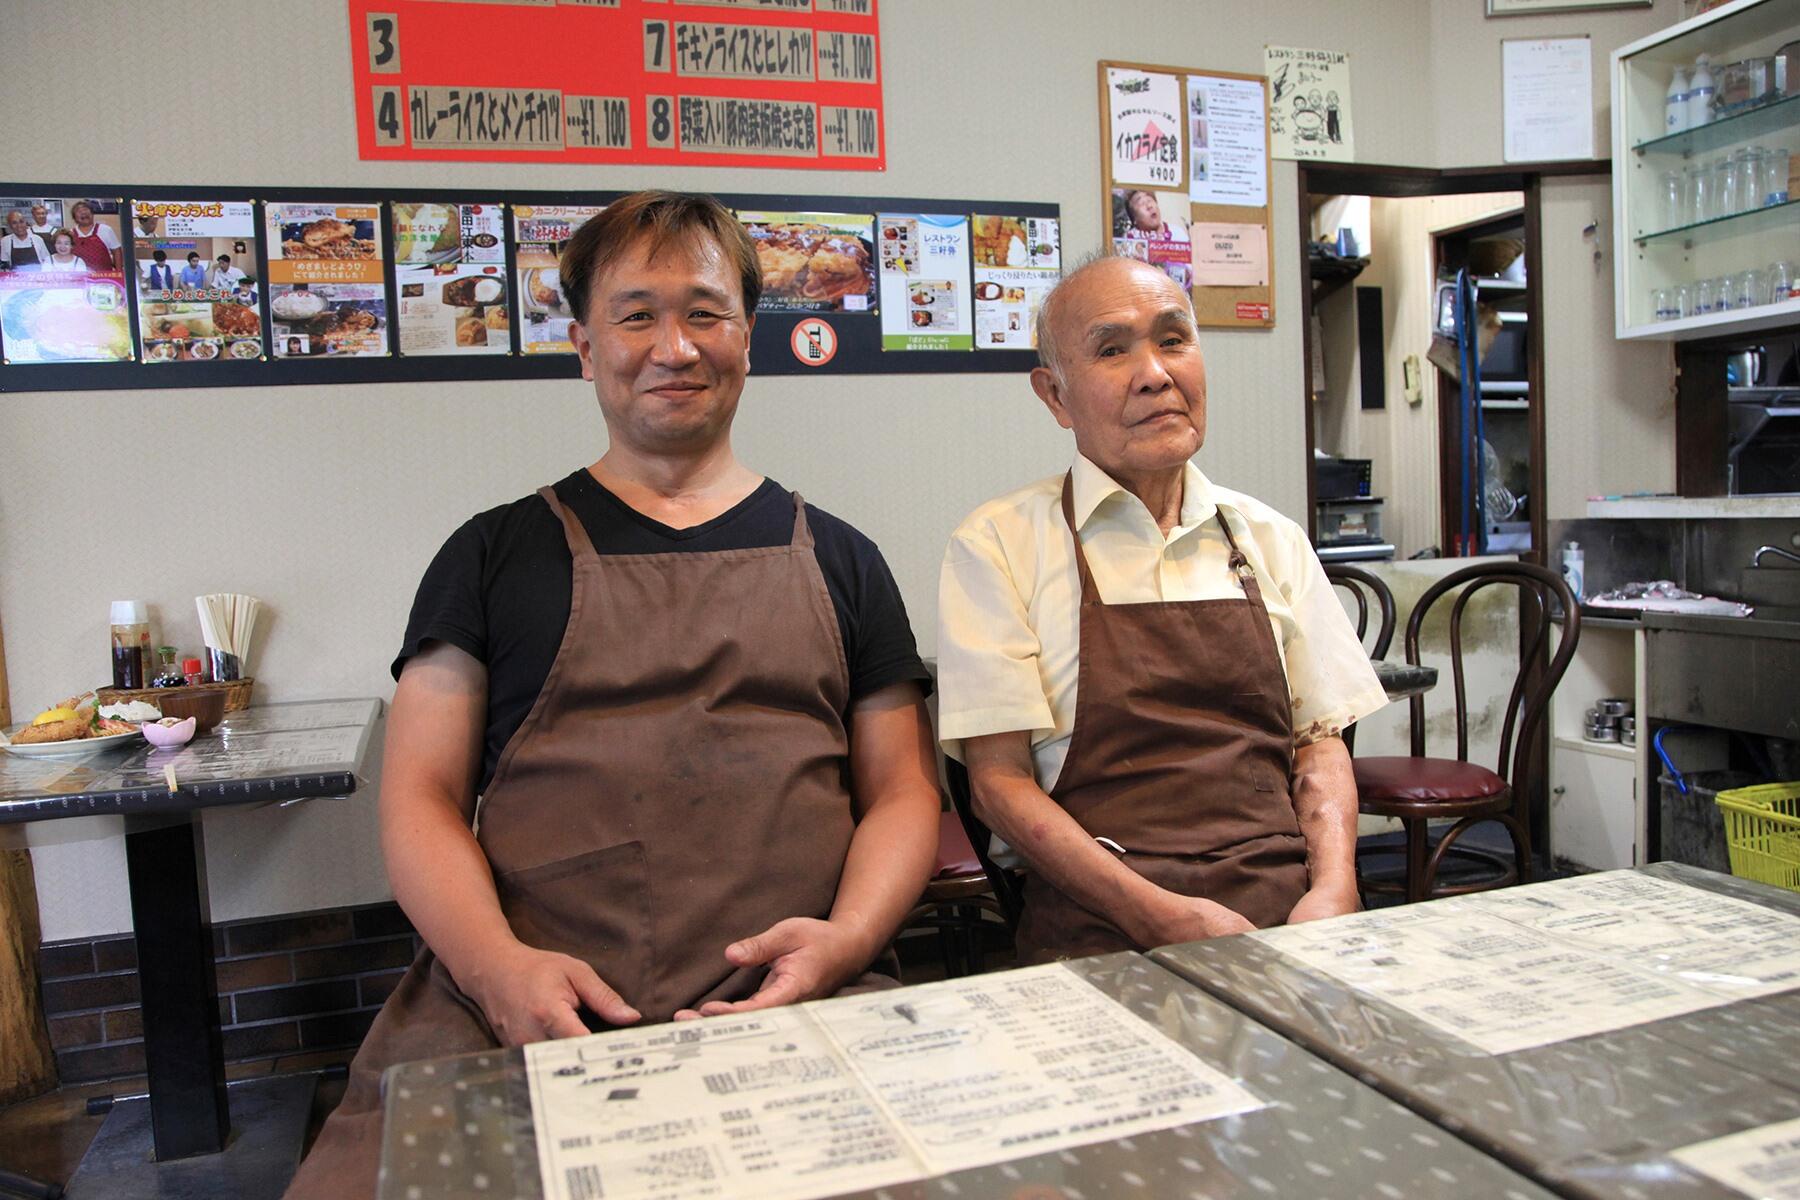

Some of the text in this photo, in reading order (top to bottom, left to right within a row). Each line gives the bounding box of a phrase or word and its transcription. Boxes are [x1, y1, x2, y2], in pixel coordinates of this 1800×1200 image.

[372, 18, 394, 65] 3
[646, 22, 666, 66] 7
[676, 23, 811, 75] チキンライスとヒレカツ
[378, 91, 399, 138] 4
[411, 88, 561, 142] カレーライスとメンチカツ
[652, 97, 671, 142] 8
[1116, 132, 1178, 164] イカフライ定食
[1149, 166, 1175, 182] ¥900
[923, 234, 960, 243] レストラン
